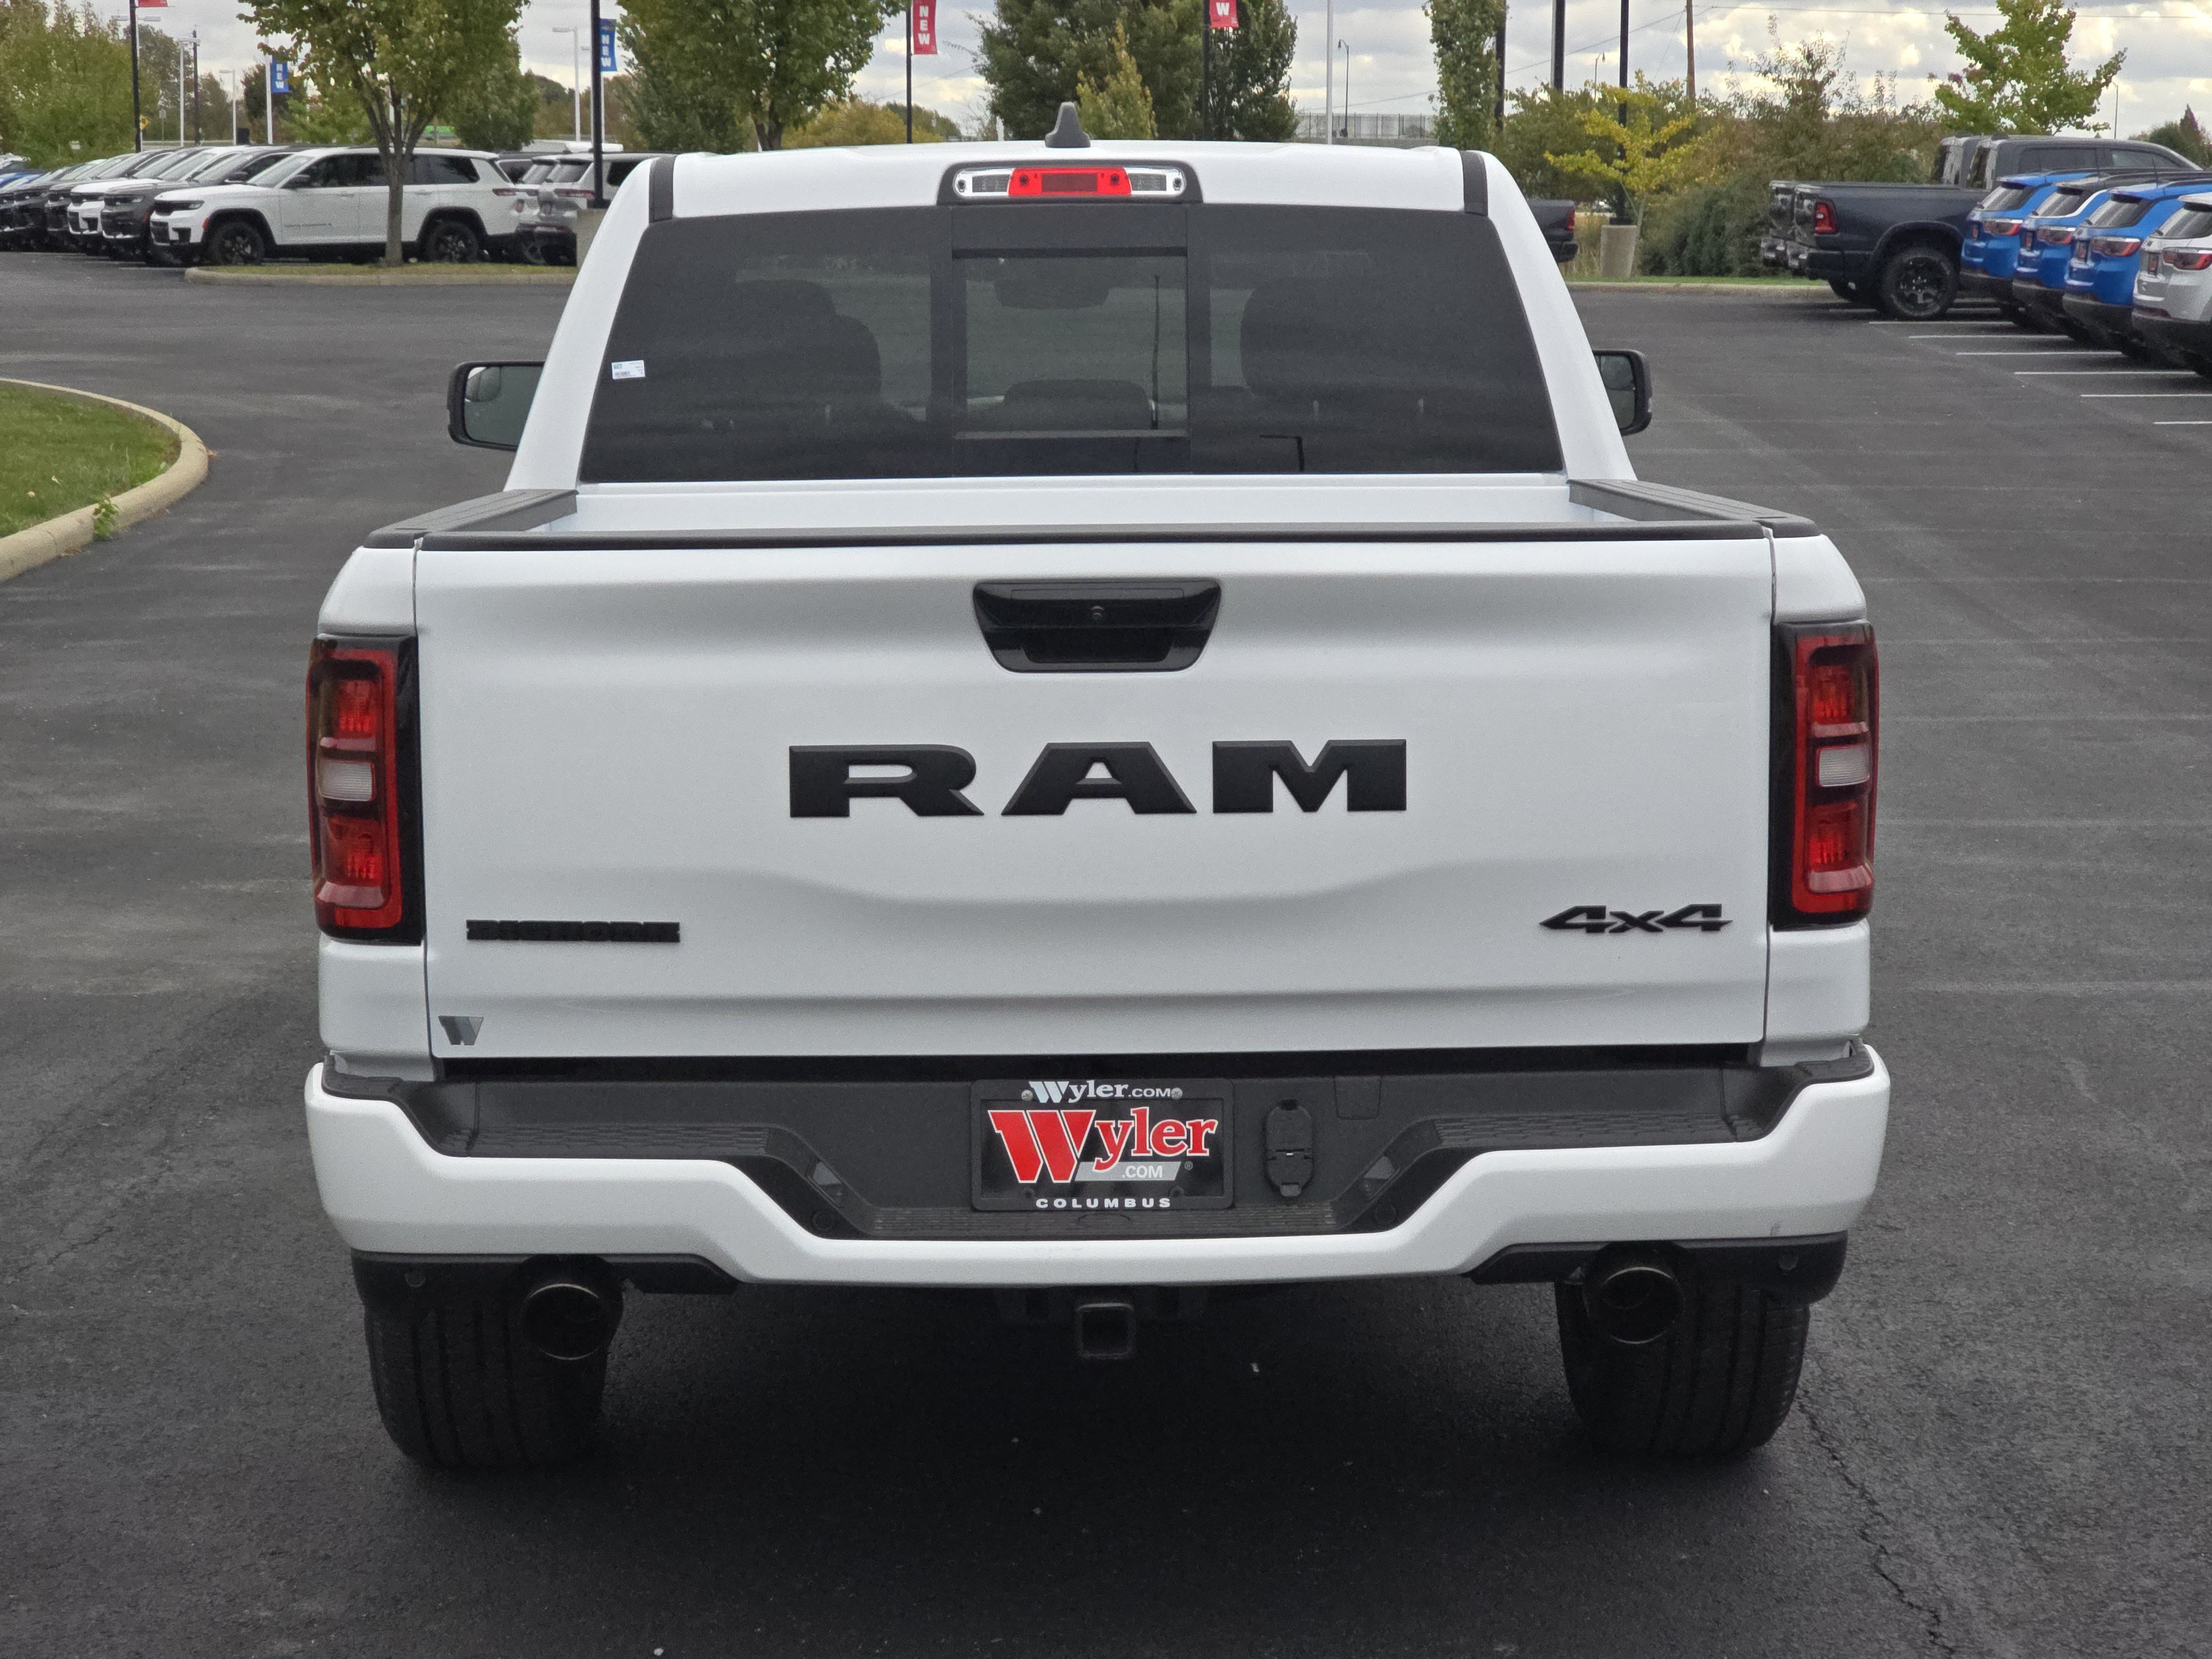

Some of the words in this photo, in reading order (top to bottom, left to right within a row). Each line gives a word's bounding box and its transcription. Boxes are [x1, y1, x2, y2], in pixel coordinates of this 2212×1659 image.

[918, 6, 930, 45] NEW
[601, 34, 611, 67] NEW
[789, 739, 1406, 818] RAM
[1540, 904, 1733, 934] 4x4
[988, 1107, 1218, 1183] Wyler
[1121, 1165, 1163, 1178] .COM
[1036, 1198, 1171, 1208] COLUMBUS
